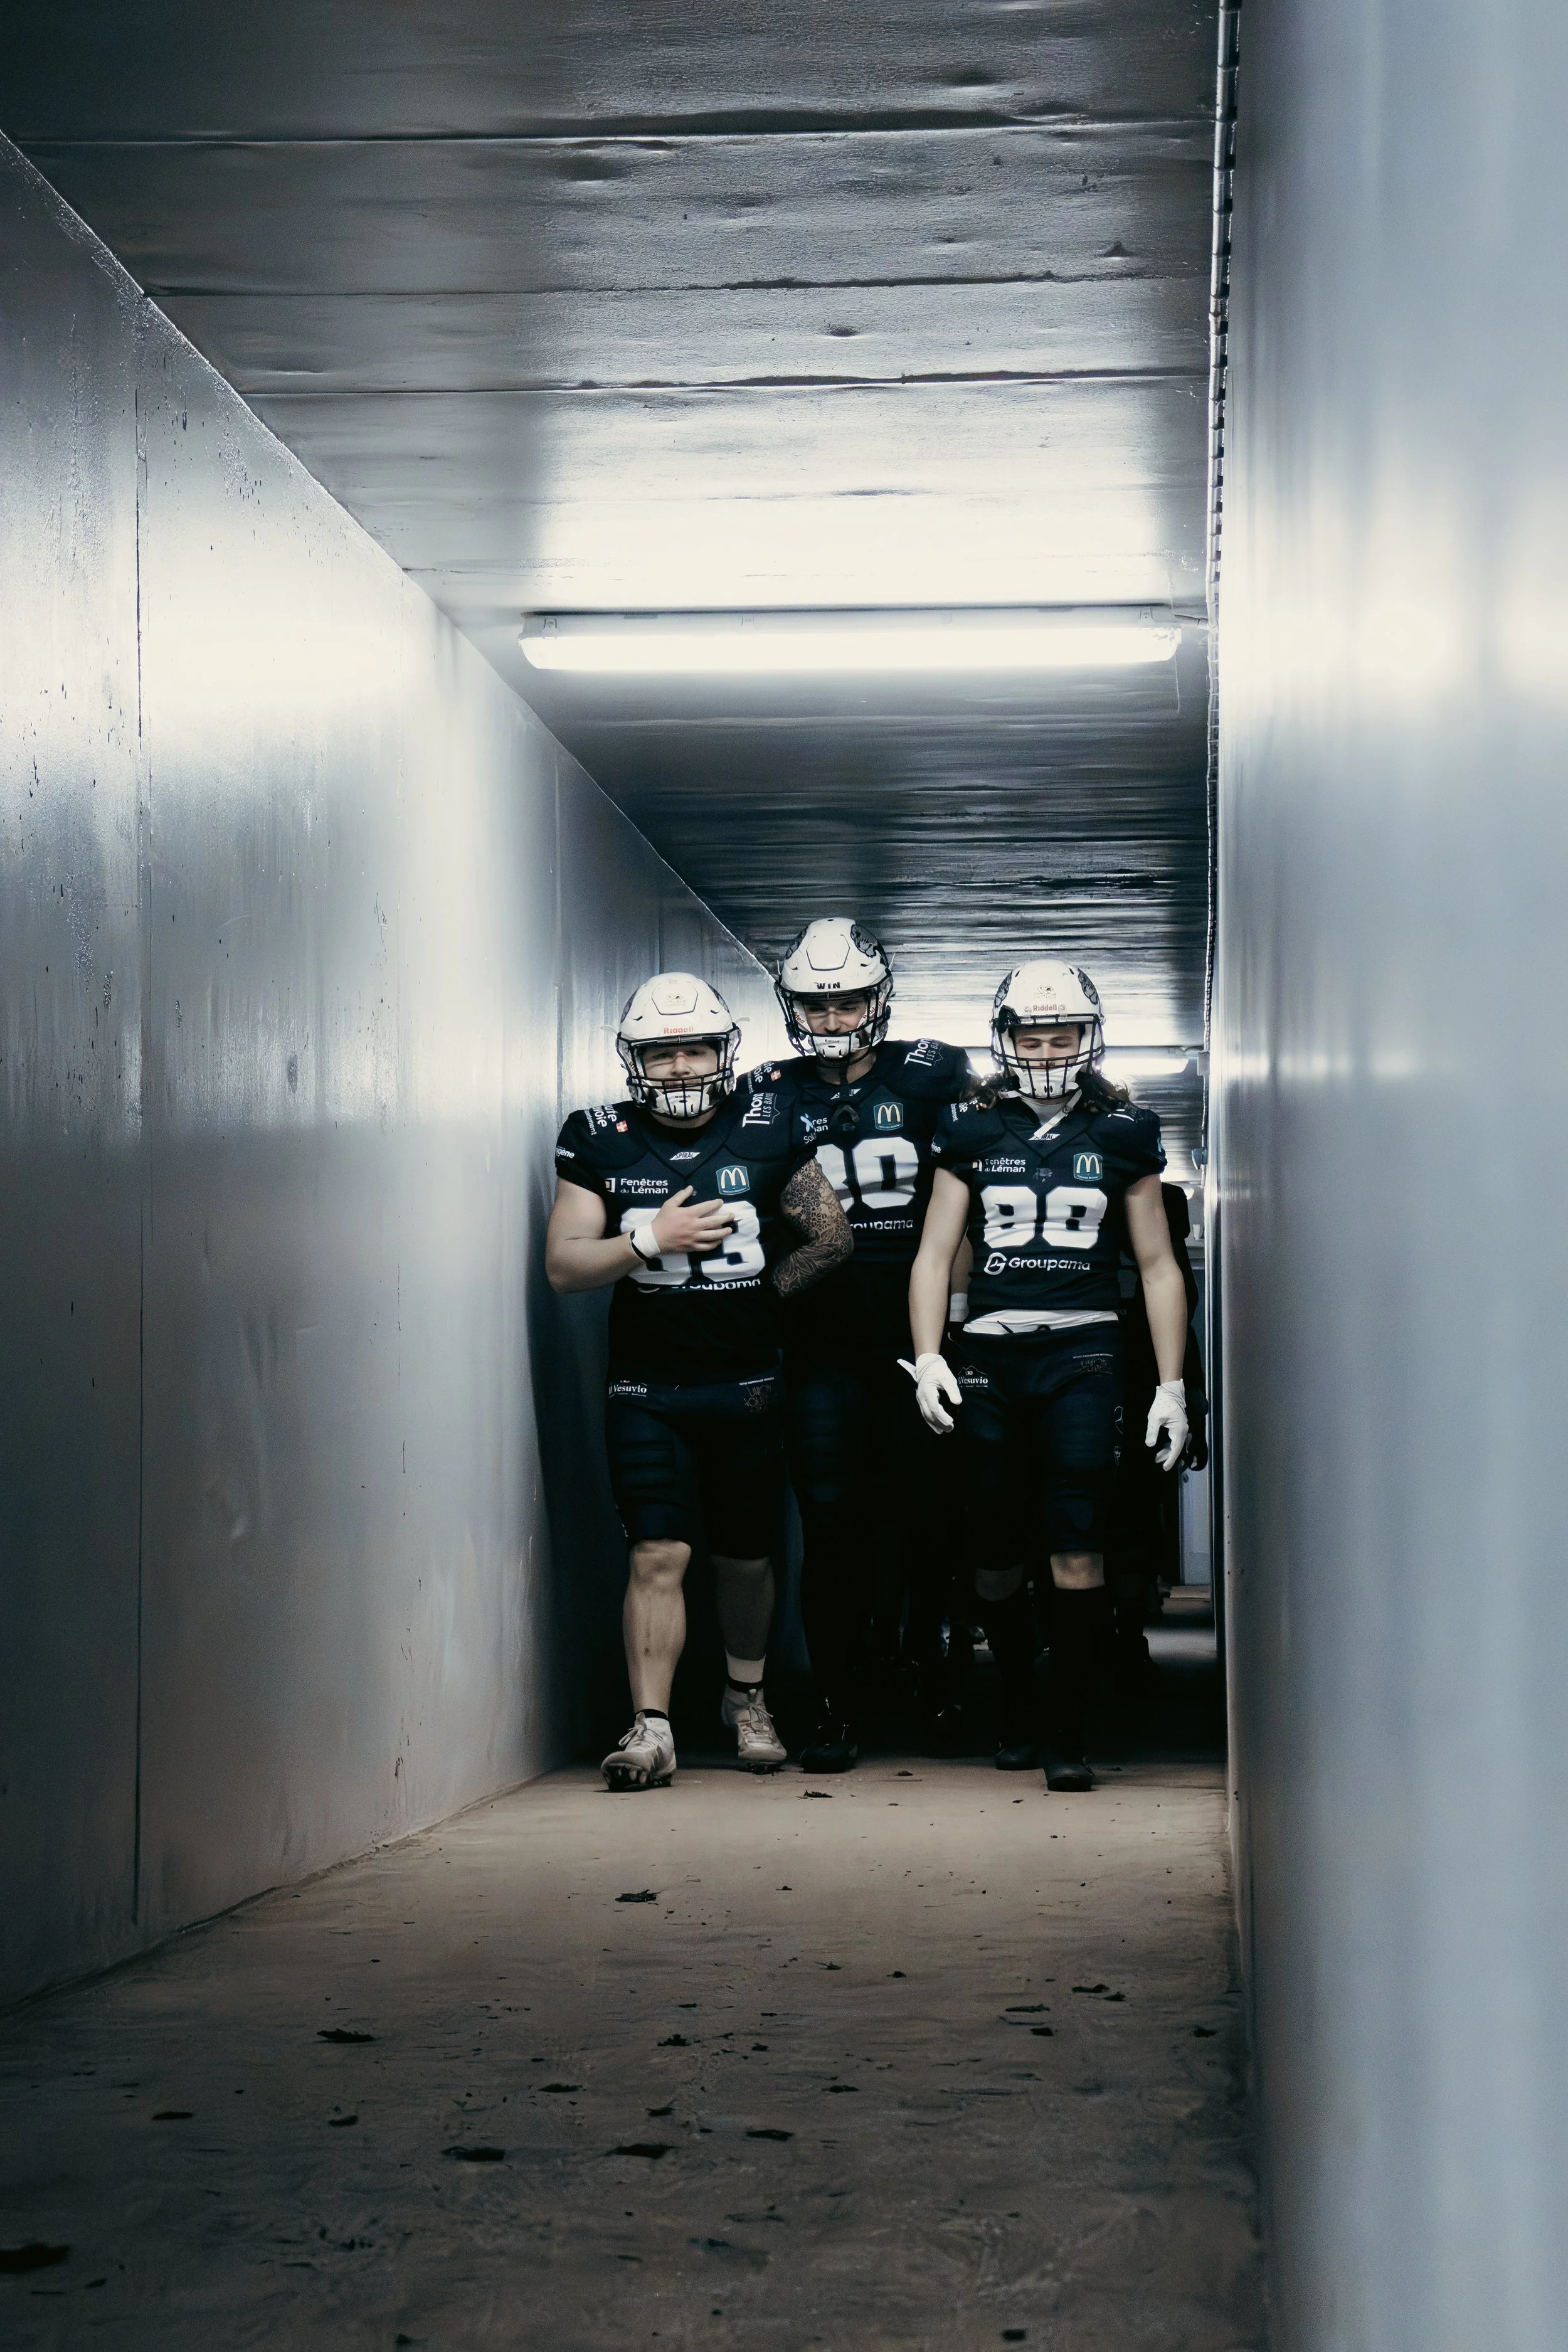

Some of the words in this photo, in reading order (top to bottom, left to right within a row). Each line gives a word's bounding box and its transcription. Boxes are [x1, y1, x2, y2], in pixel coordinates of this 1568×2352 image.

[664, 1026, 694, 1034] Riddell
[762, 1106, 771, 1117] LES
[1009, 1257, 1091, 1271] Groupama
[613, 1384, 647, 1394] Vesuvio
